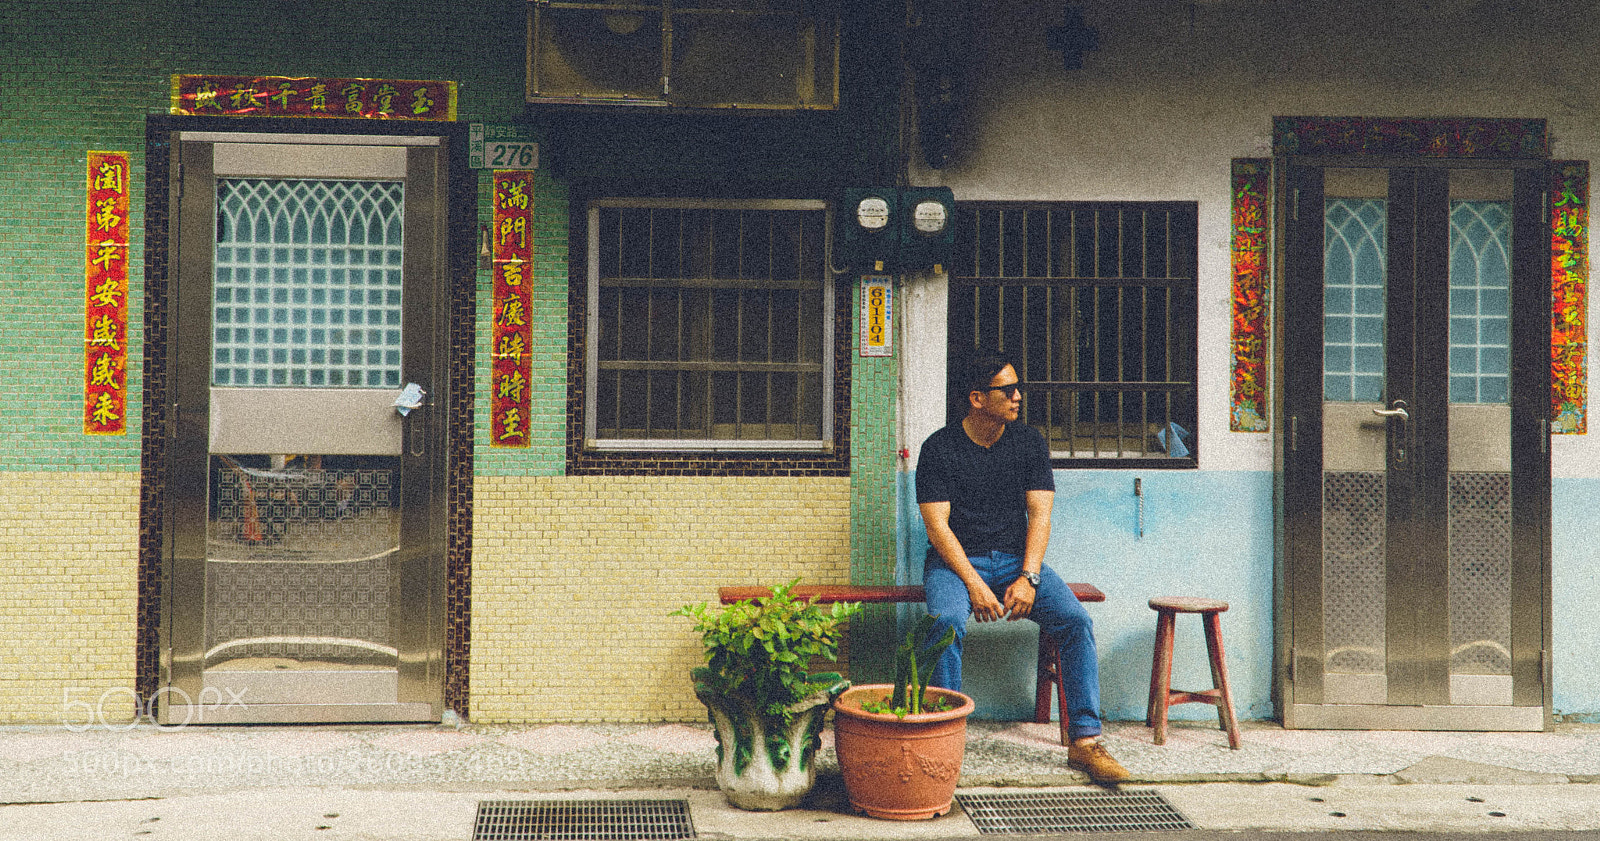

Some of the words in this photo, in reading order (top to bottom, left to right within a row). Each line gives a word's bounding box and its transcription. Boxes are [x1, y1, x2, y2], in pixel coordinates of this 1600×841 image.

[491, 144, 533, 167] 276
[498, 179, 529, 440] 滿門吉慶時時至
[871, 288, 882, 343] 601104
